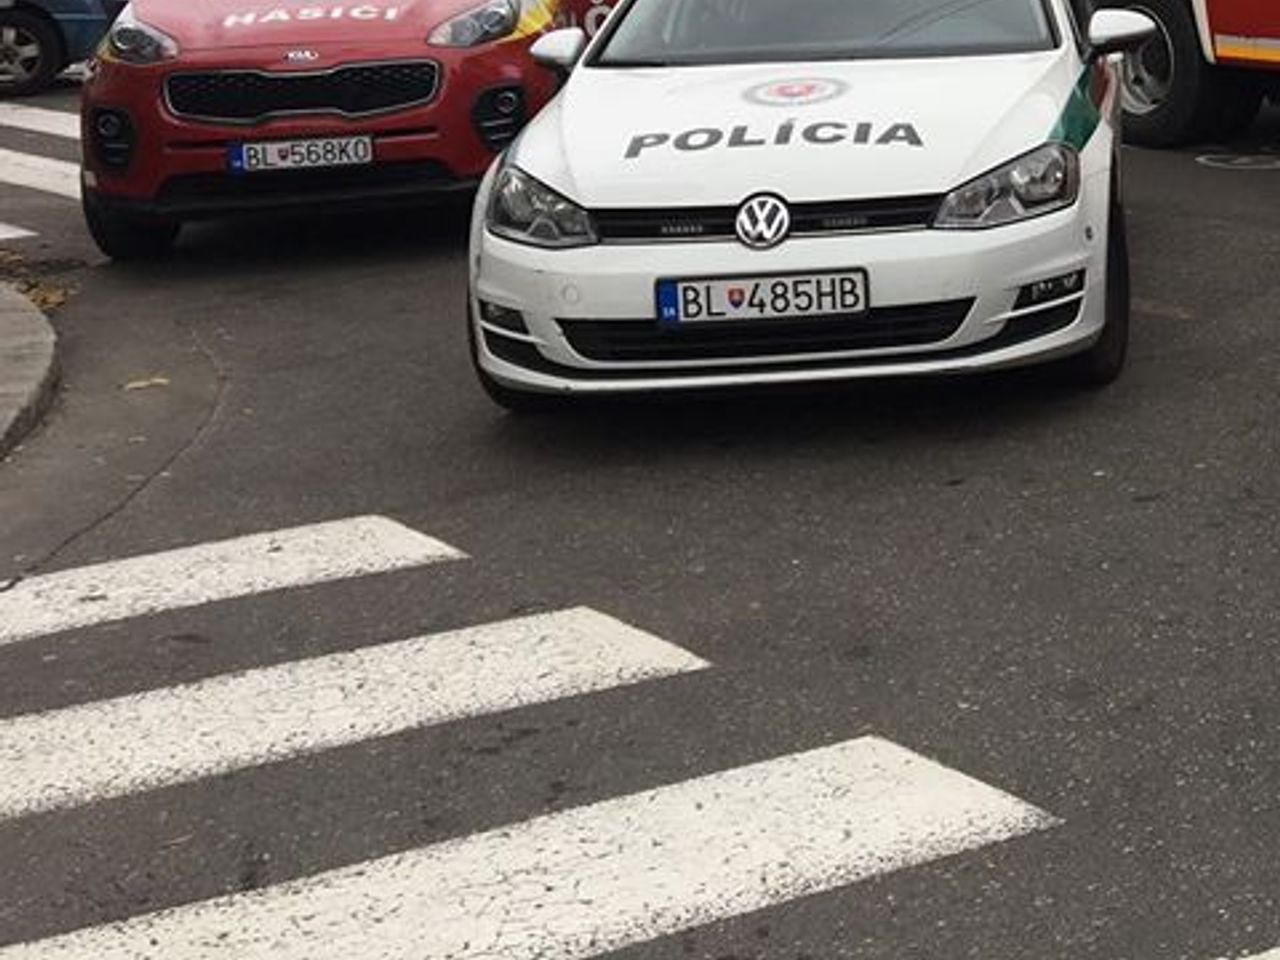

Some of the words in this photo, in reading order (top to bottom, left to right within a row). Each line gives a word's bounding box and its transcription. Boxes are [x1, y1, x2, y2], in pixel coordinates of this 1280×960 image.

[246, 146, 277, 169] BL
[623, 117, 924, 159] POLÍCIA
[682, 284, 726, 319] BL
[749, 277, 861, 314] 485HB
